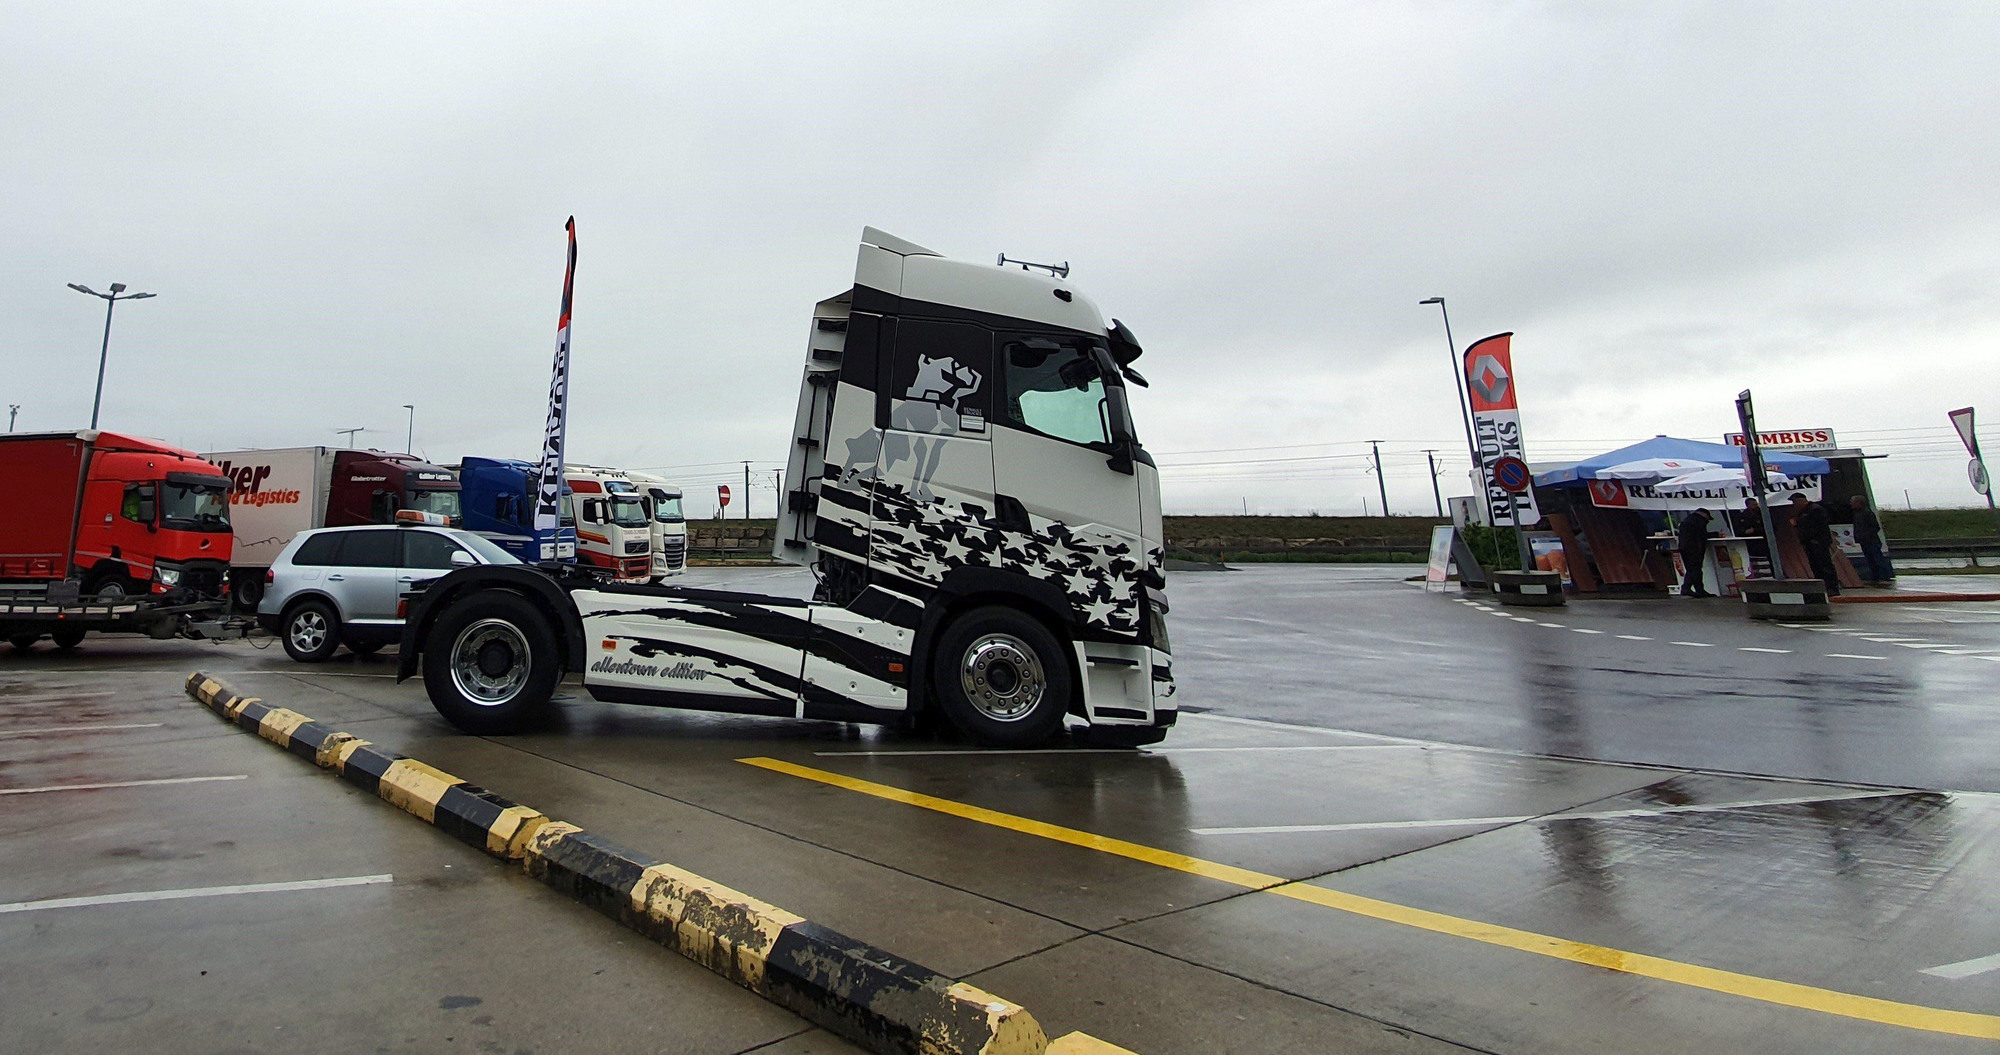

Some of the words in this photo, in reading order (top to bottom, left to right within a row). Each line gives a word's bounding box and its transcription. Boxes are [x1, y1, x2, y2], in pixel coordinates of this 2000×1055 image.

[1498, 421, 1532, 510] TCKS
[243, 487, 300, 508] Logistics
[1736, 474, 1820, 498] TUCKS
[590, 656, 660, 677] allentown
[660, 662, 708, 681] edition
